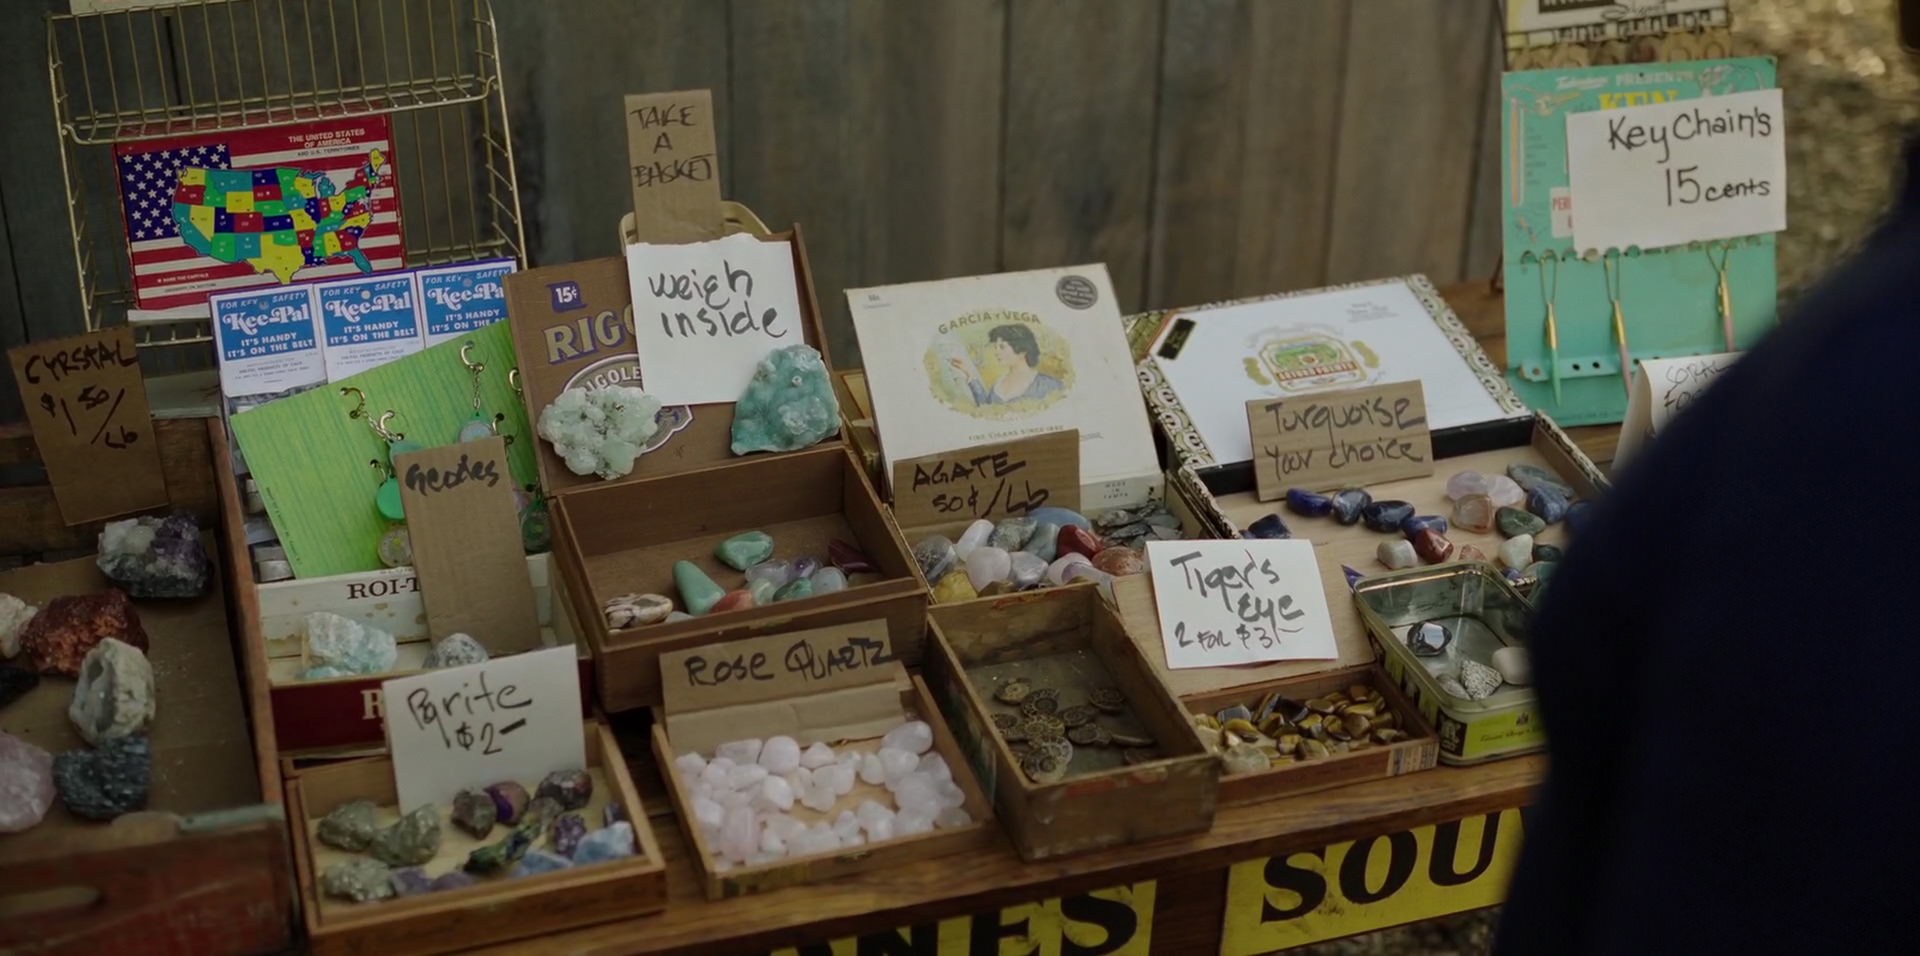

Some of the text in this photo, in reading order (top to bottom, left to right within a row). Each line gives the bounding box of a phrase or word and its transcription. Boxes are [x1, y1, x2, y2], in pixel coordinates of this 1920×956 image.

[629, 104, 696, 130] TAKE
[288, 128, 365, 143] THE UNITED STATES
[316, 138, 351, 148] AMERICA
[653, 132, 672, 154] A
[632, 153, 716, 187] BASKET
[323, 280, 408, 297] FOR KEY SAFETY
[425, 268, 510, 284] FOR KEY SAFETY
[648, 259, 753, 310] weigh
[220, 292, 306, 310] FOR KEY SAFETY
[555, 286, 577, 304] 15¢
[343, 321, 399, 334] IT'S HANDY
[431, 324, 450, 332] IT'S
[453, 321, 469, 330] ON
[445, 309, 500, 322] IT'S HANDY
[661, 300, 787, 338] inside
[938, 311, 992, 335] GARCIA
[1002, 310, 1042, 325] VEGA
[241, 332, 297, 347] IT'S HANDY
[330, 327, 415, 344] IT'S ON THE BELT
[227, 339, 313, 358] IT'S ON THE BELT
[25, 339, 139, 384] CYRSTAL
[1265, 396, 1426, 449] Turquoise
[1329, 437, 1423, 469] choice
[404, 453, 500, 497] Geodes
[912, 450, 1027, 492] AGATE
[1170, 549, 1280, 613] Tiger's
[1175, 621, 1194, 648] 2
[1197, 630, 1231, 652] FOR
[785, 637, 894, 681] QUARTZ
[406, 671, 533, 749] Pyrite
